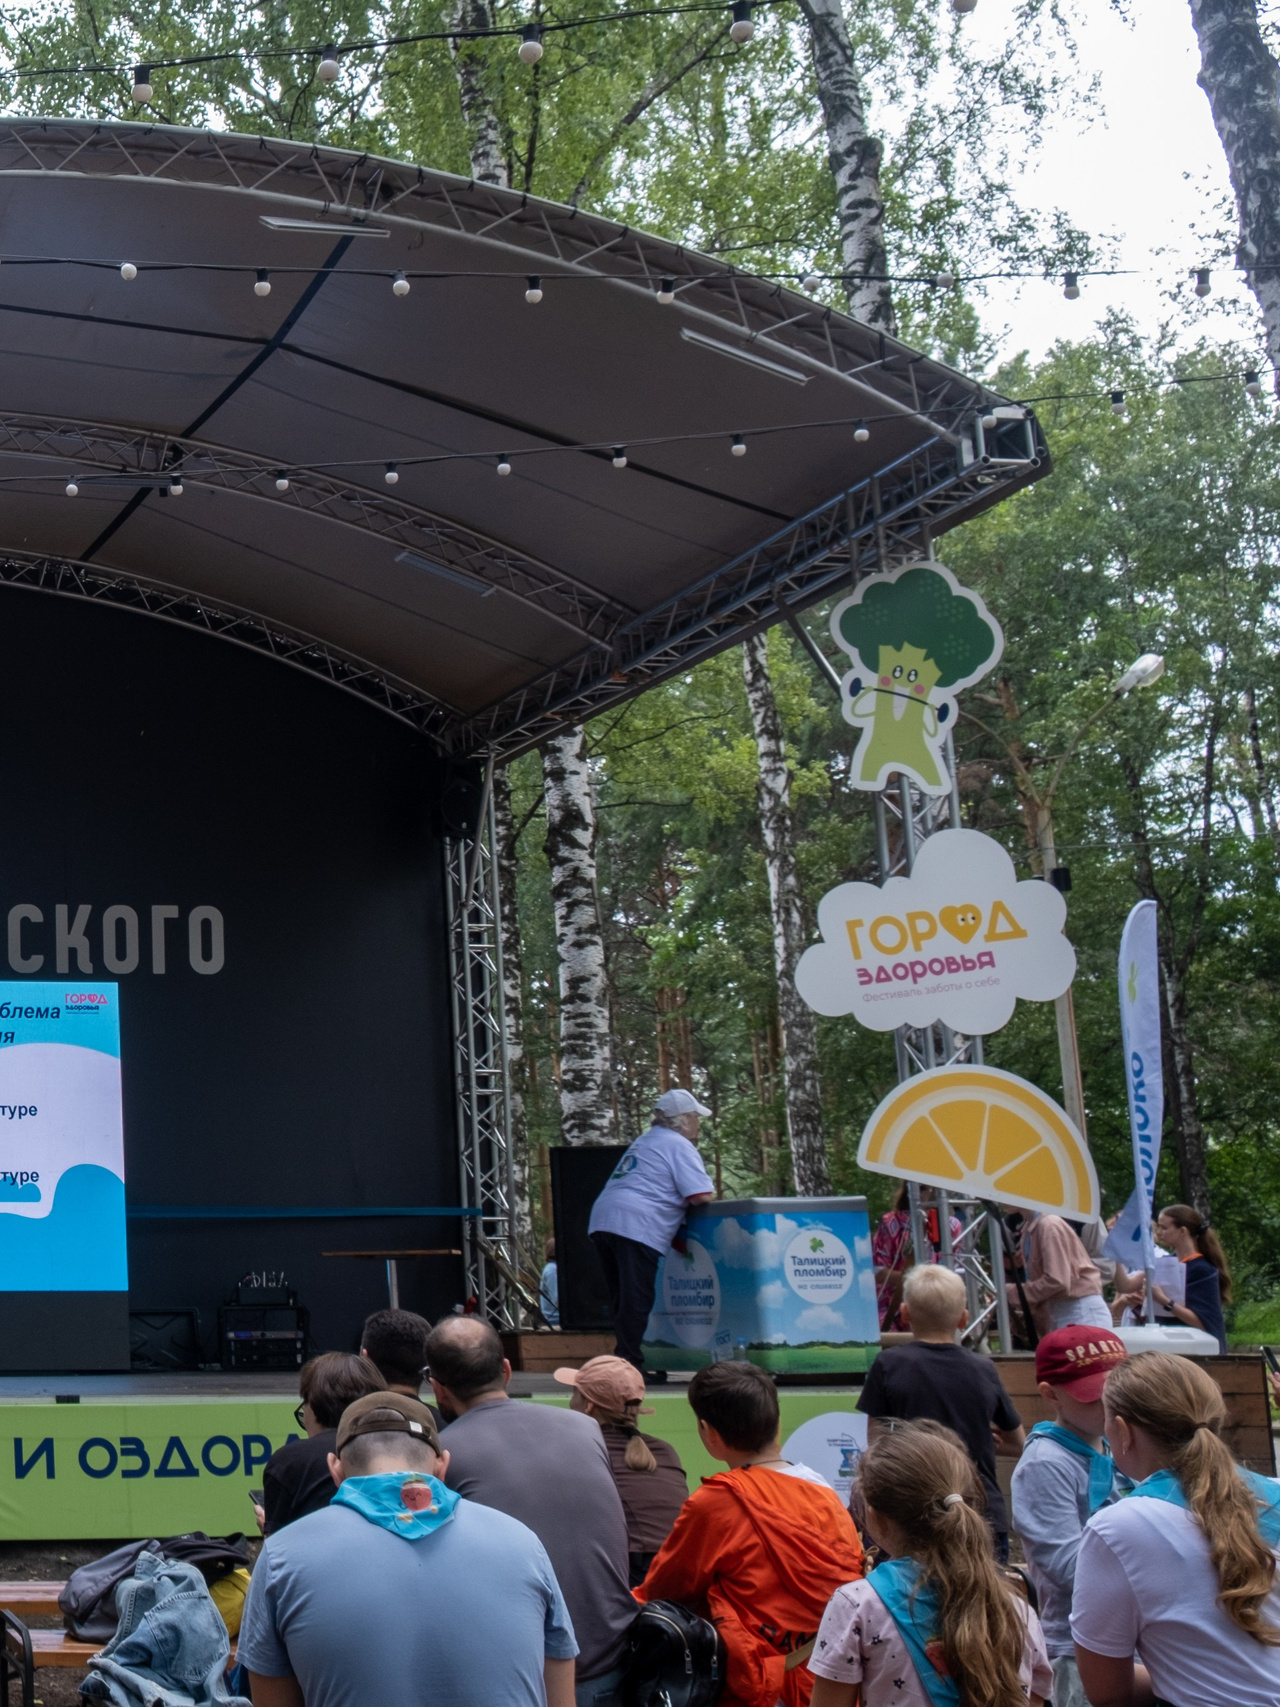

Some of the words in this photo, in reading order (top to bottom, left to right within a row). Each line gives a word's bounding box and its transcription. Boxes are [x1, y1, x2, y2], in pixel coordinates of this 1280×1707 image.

[862, 986, 923, 1003] Фестиваль
[925, 982, 963, 996] заботы
[965, 980, 973, 989] о
[975, 975, 1001, 989] себе
[790, 1254, 847, 1267] Талицкий
[793, 1266, 847, 1279] пломбир
[14, 1436, 56, 1480] И
[77, 1433, 301, 1479] ОЗДОР
